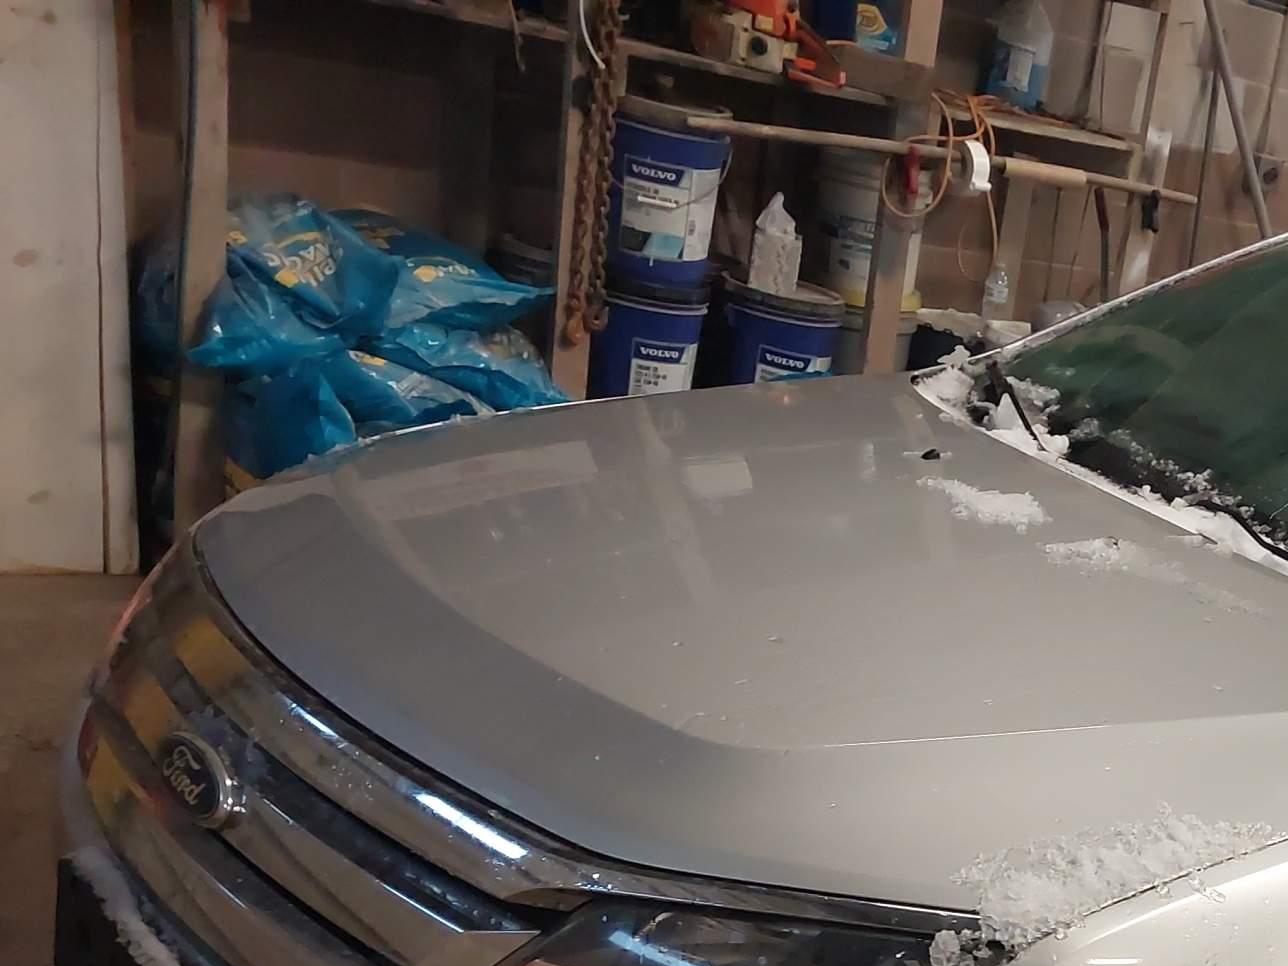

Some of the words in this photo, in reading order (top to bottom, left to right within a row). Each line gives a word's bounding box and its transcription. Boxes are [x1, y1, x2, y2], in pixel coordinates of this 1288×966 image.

[631, 163, 677, 181] VOLVO
[639, 346, 680, 359] VOLVO
[765, 352, 805, 369] VOLVO
[163, 746, 206, 805] Ford
